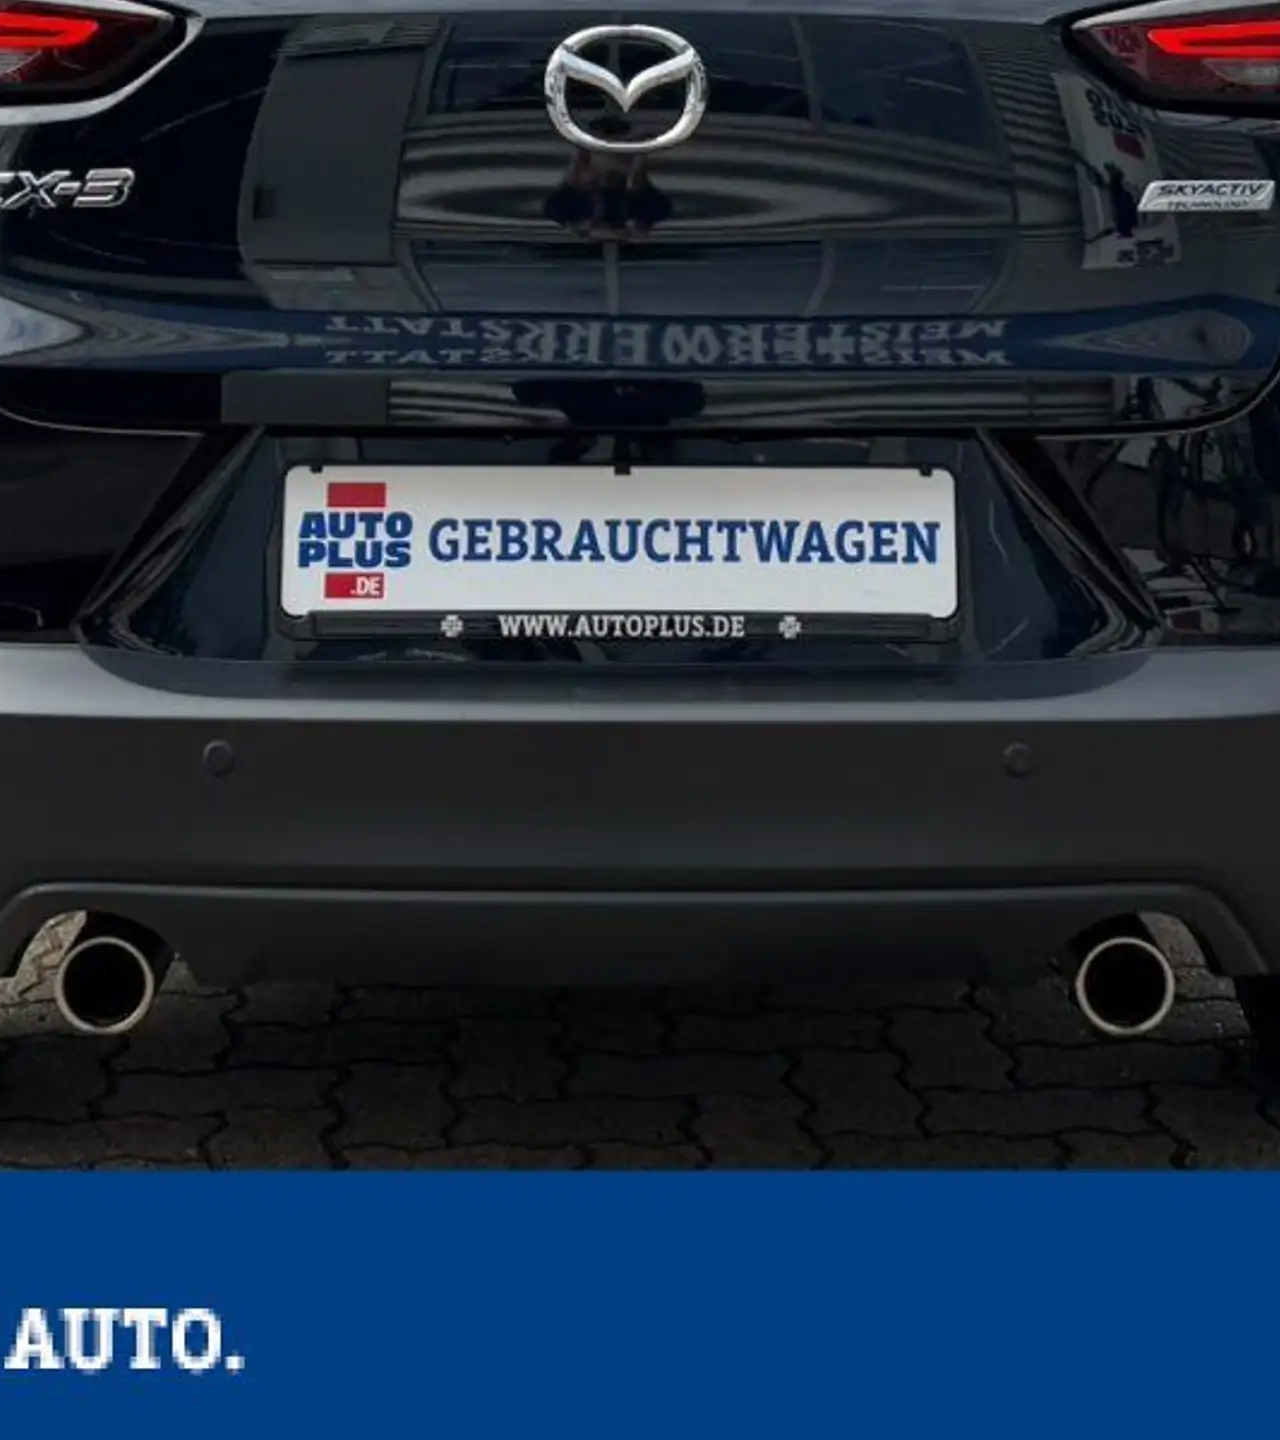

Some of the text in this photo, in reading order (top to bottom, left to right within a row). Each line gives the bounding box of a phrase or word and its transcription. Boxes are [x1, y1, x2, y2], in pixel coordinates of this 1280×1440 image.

[1156, 182, 1264, 197] SKYACTIV
[298, 511, 413, 539] AUTO
[428, 517, 941, 564] GEBRAUCHTWAGEN
[297, 540, 412, 569] PLUS
[349, 575, 382, 597] .DE
[498, 614, 747, 639] WWW.AUTOPLUS.DE
